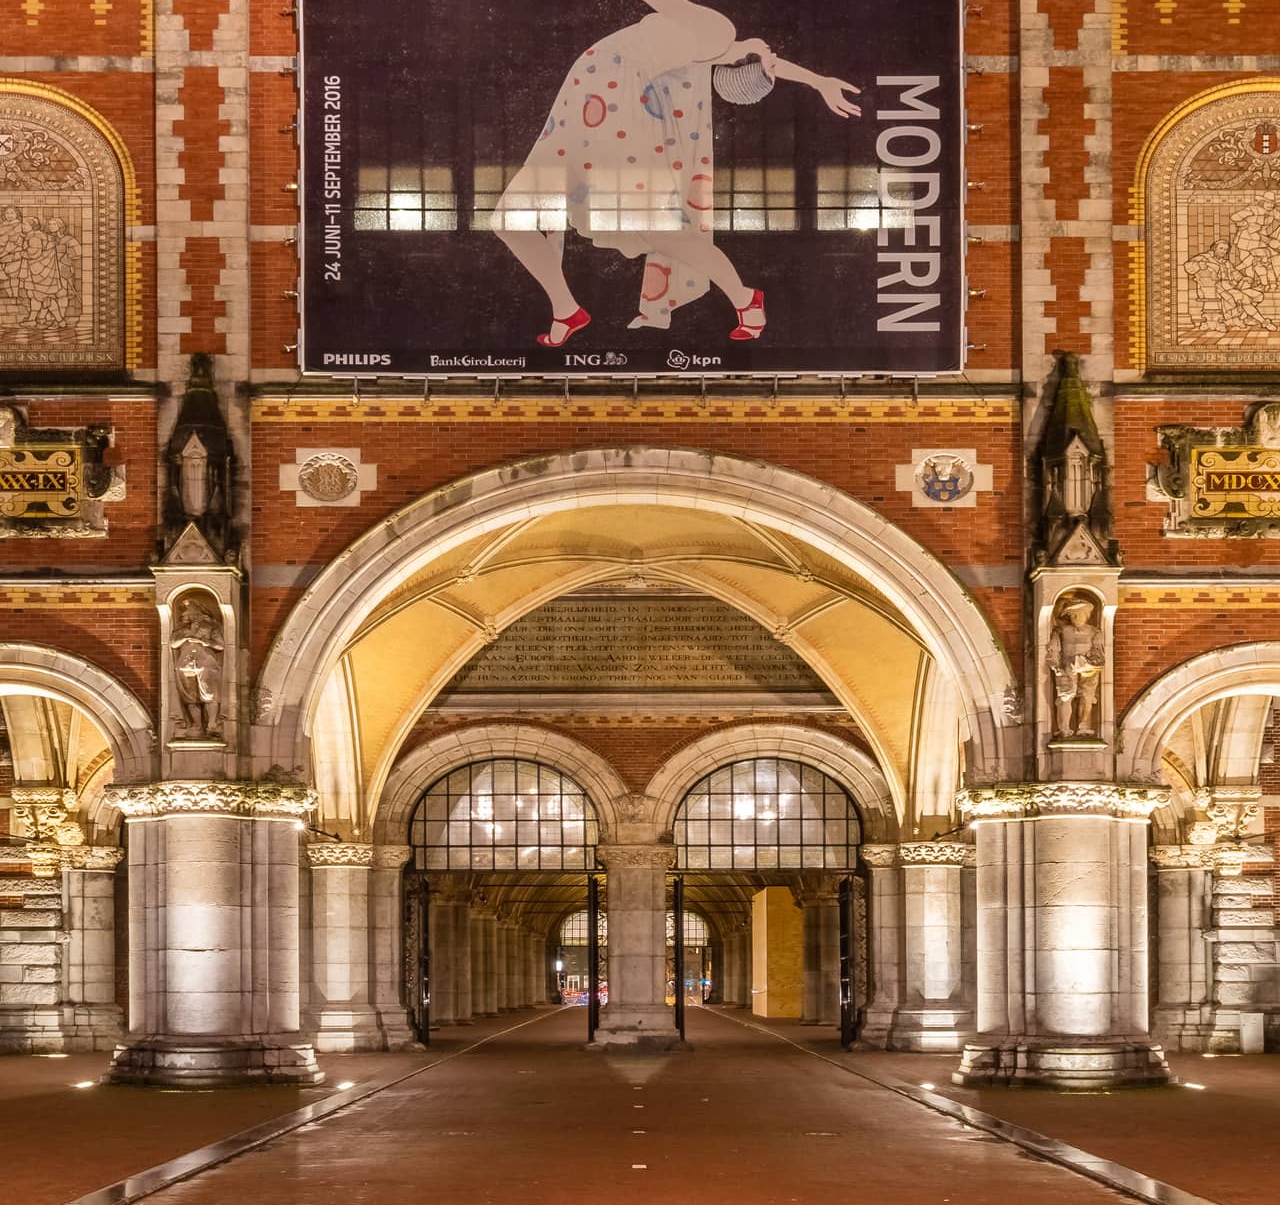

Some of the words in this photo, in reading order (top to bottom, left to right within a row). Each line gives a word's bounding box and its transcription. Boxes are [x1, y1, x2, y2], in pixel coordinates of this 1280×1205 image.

[324, 75, 341, 110] 2016
[324, 114, 341, 199] SEPTEMBER
[875, 75, 941, 332] MODERN
[324, 262, 341, 281] 24
[323, 353, 392, 365] PHILIPS
[430, 354, 527, 370] BankGiroLoterij
[564, 354, 601, 366] ING
[692, 354, 722, 367] kpn
